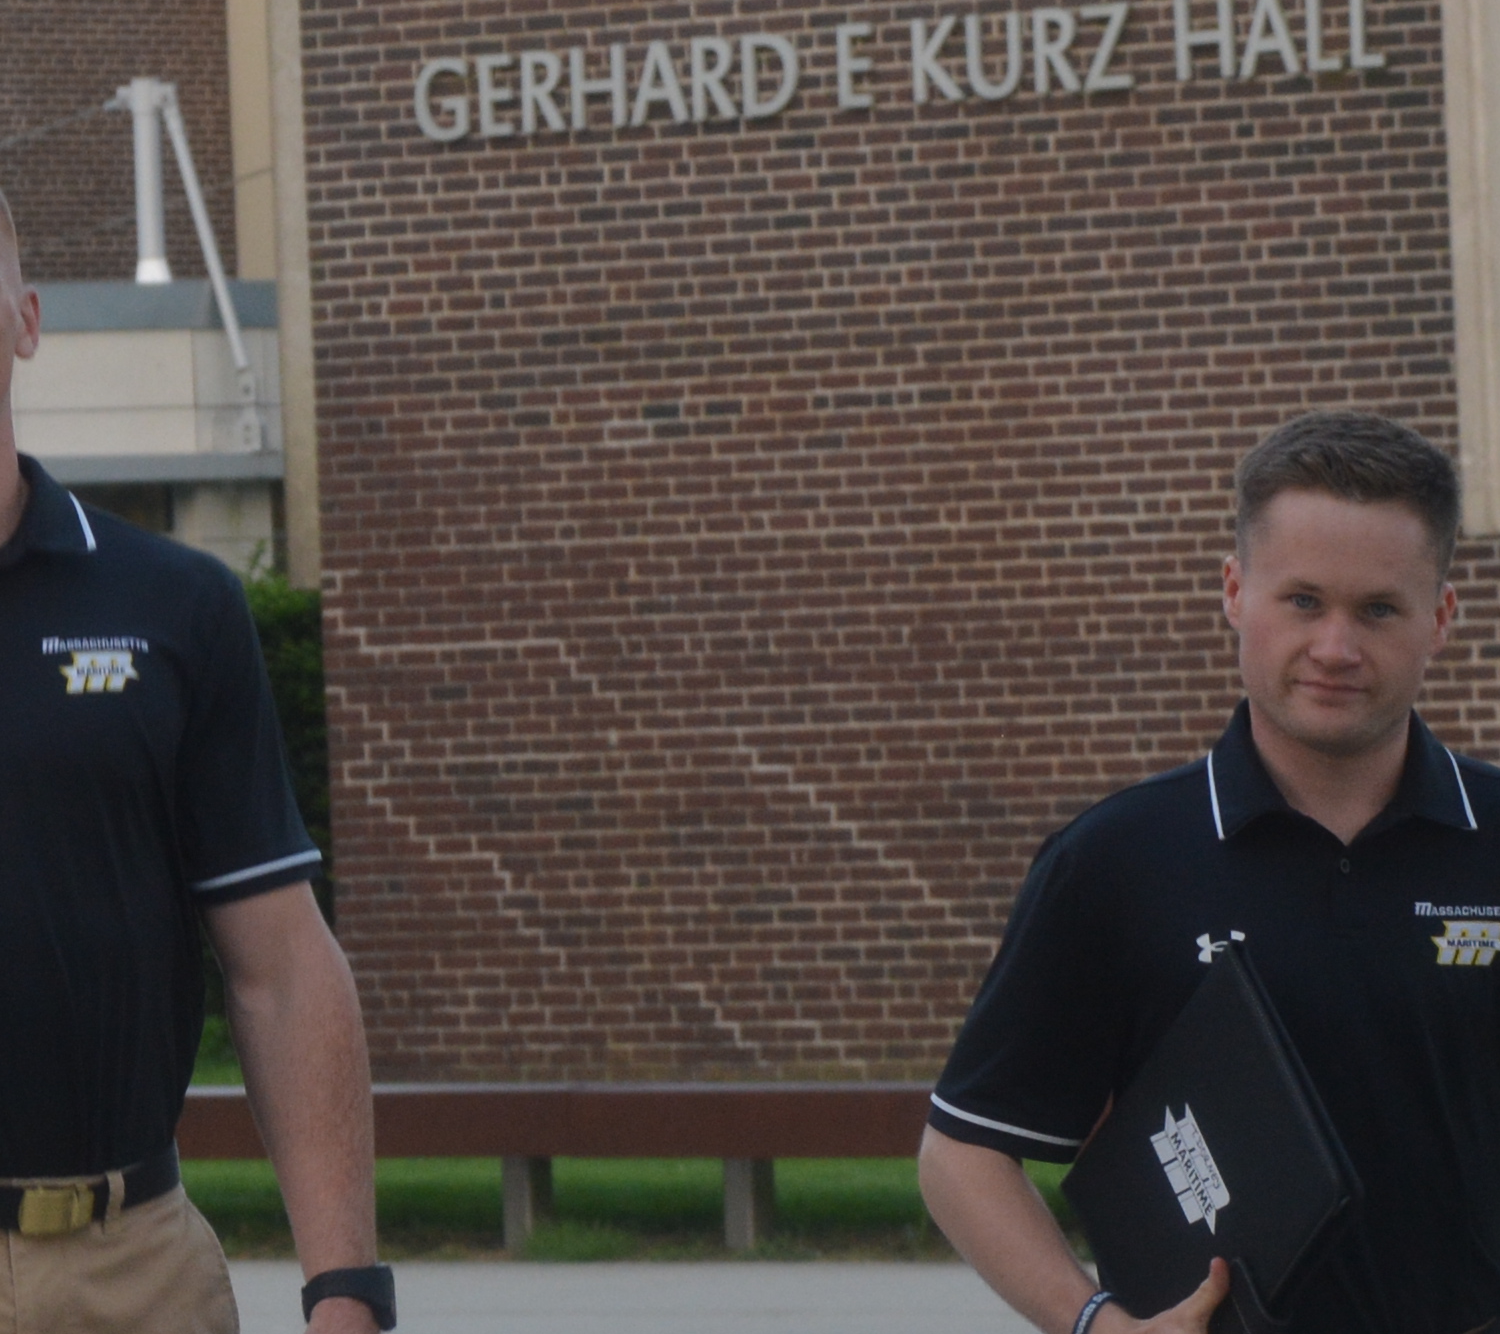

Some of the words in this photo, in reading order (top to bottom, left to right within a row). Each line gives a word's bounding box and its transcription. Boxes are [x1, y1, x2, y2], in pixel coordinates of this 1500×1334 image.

[414, 31, 798, 143] GERHARD
[836, 22, 874, 112] E
[910, 2, 1134, 105] KURZ
[1446, 938, 1496, 948] MARITIME
[1170, 1131, 1213, 1216] MARITIME
